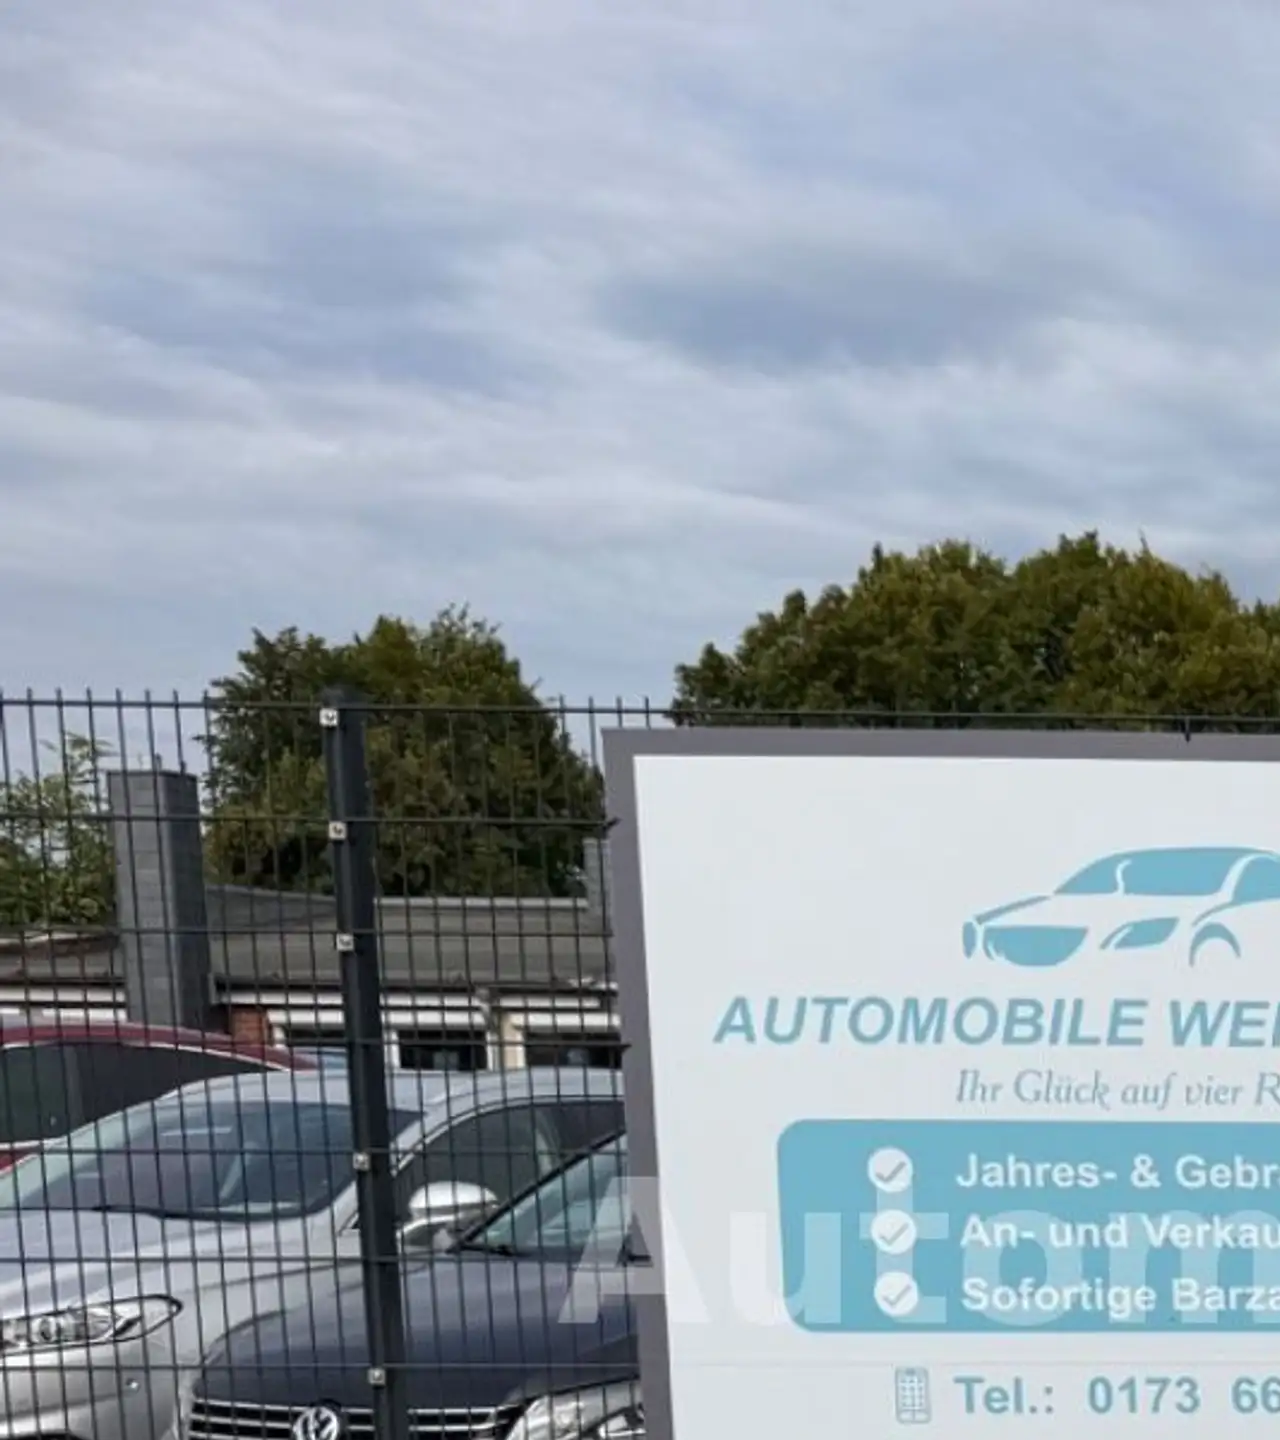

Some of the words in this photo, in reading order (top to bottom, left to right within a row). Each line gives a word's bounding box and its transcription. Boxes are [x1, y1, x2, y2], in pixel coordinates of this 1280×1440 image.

[713, 996, 1150, 1047] AUTOMOBILE
[956, 1068, 1003, 1105] Ihr
[1013, 1068, 1110, 1111] Glück
[1120, 1071, 1179, 1111] auf
[1185, 1077, 1243, 1107] vier
[956, 1153, 1118, 1188] Jahres-
[1130, 1154, 1162, 1189] &
[960, 1213, 1036, 1249] An-
[1050, 1214, 1128, 1249] und
[962, 1276, 1157, 1320] Sofortige
[953, 1375, 1054, 1414] Tel.:
[1088, 1375, 1200, 1414] 0173
